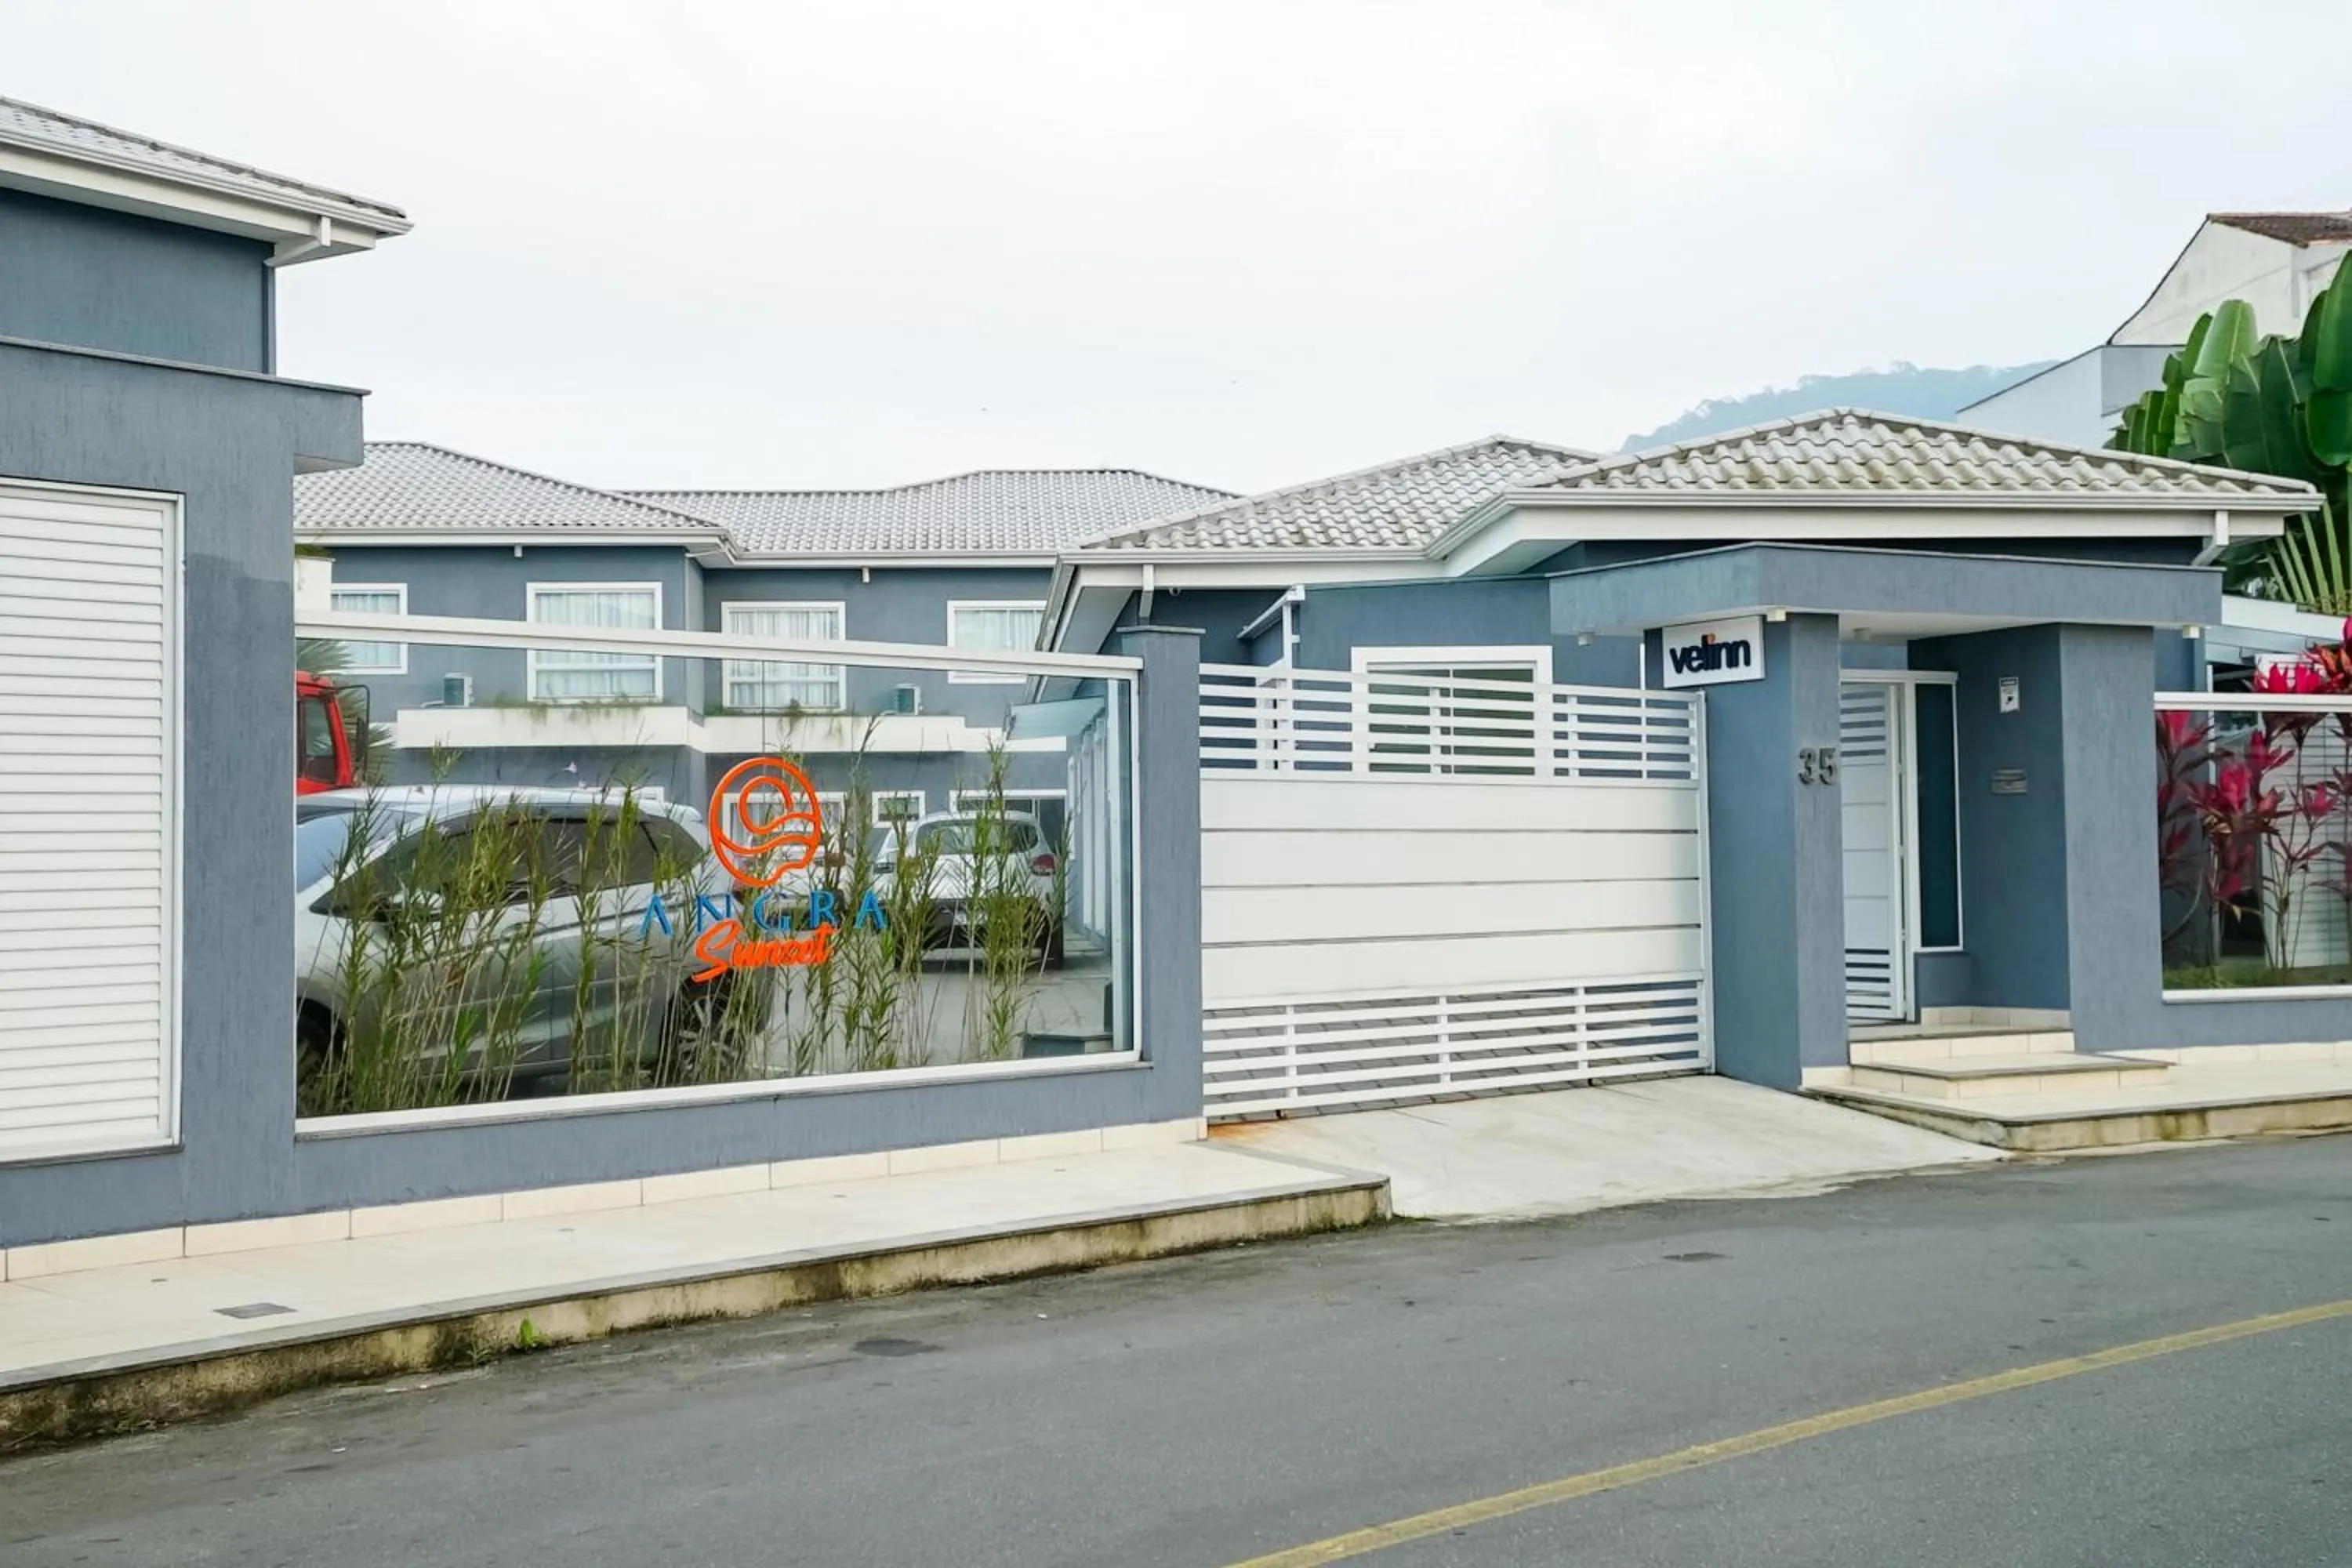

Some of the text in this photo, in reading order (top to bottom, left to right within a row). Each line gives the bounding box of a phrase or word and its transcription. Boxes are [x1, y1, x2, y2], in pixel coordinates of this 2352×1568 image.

[1798, 747, 1837, 786] 35
[639, 889, 889, 936] ANGRA
[691, 919, 838, 983] Sunset
